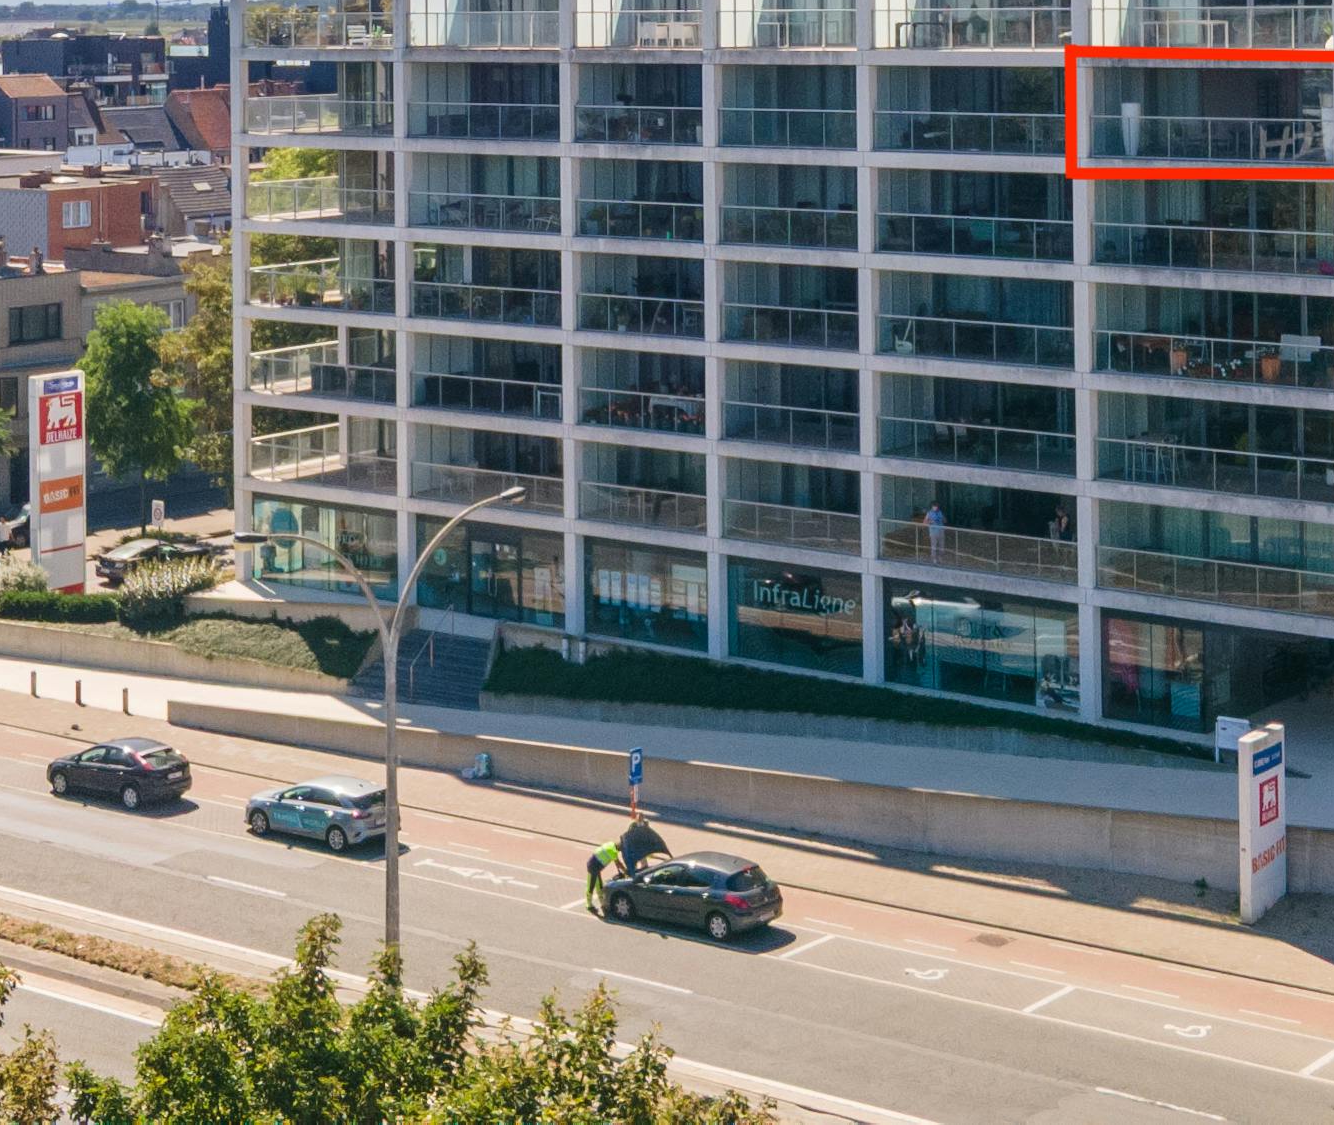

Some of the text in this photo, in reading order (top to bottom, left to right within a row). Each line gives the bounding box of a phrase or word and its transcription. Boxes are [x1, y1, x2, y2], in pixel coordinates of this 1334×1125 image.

[45, 427, 77, 444] DELHAIZE
[753, 580, 857, 616] InfraLigne
[632, 753, 641, 773] P
[413, 859, 540, 889] TAXI
